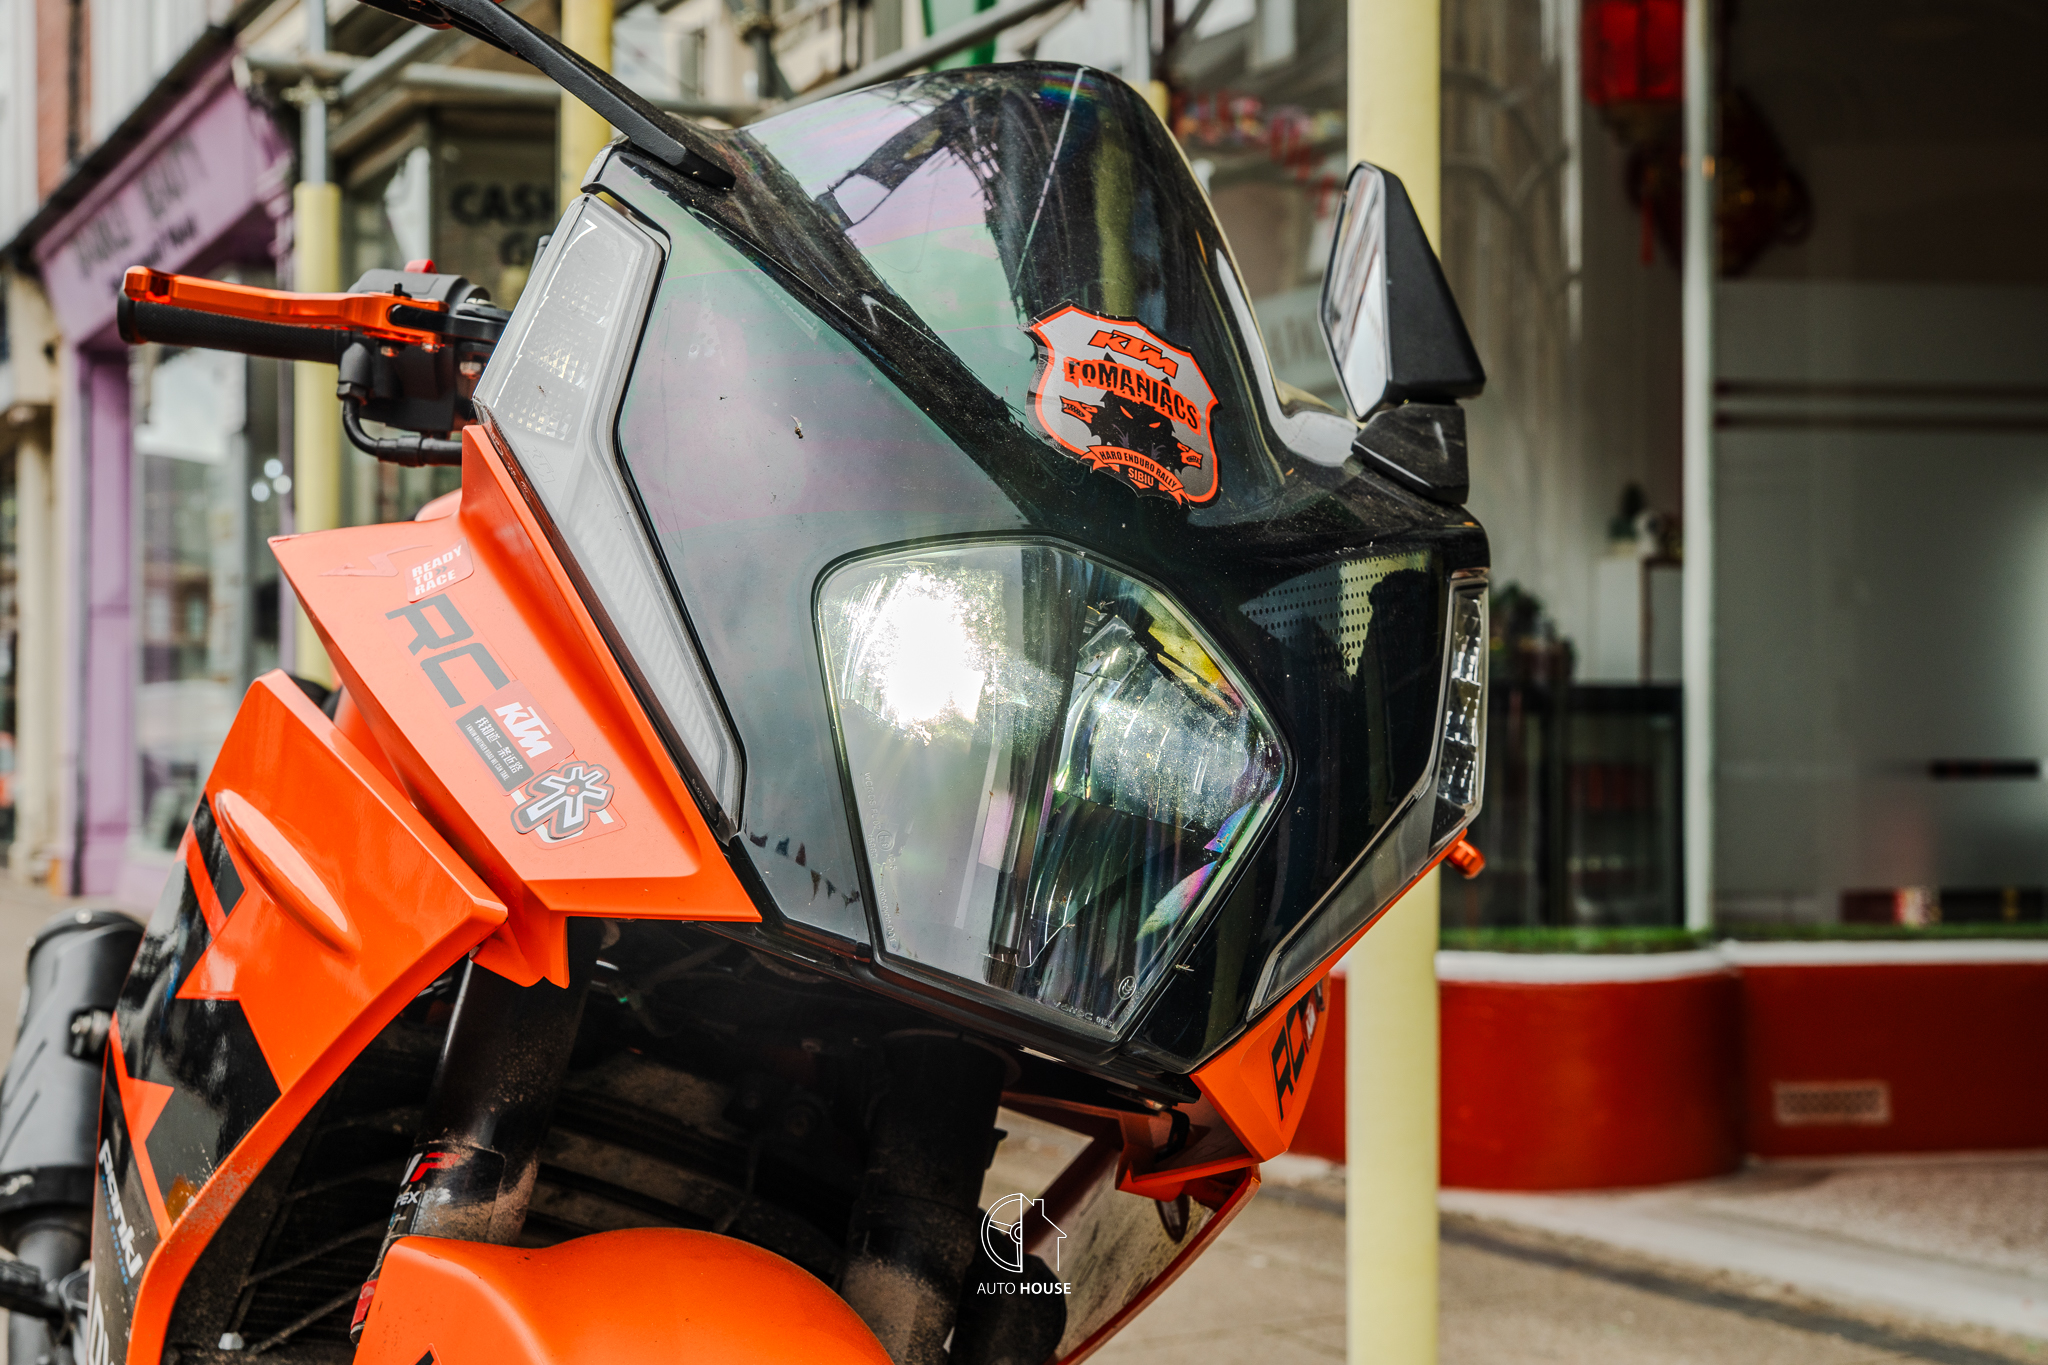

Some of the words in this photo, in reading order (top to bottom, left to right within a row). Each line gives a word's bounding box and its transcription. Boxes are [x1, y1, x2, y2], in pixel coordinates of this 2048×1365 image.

[1088, 330, 1179, 378] KTM
[1124, 452, 1155, 472] ENDURO
[1155, 468, 1178, 488] RALLY
[1127, 467, 1154, 486] SIBIU
[411, 544, 462, 578] READY
[413, 570, 434, 586] TO
[414, 569, 456, 596] RACE
[384, 593, 511, 709] RC
[475, 716, 524, 774] 我知道一条近路
[494, 701, 553, 759] KTM
